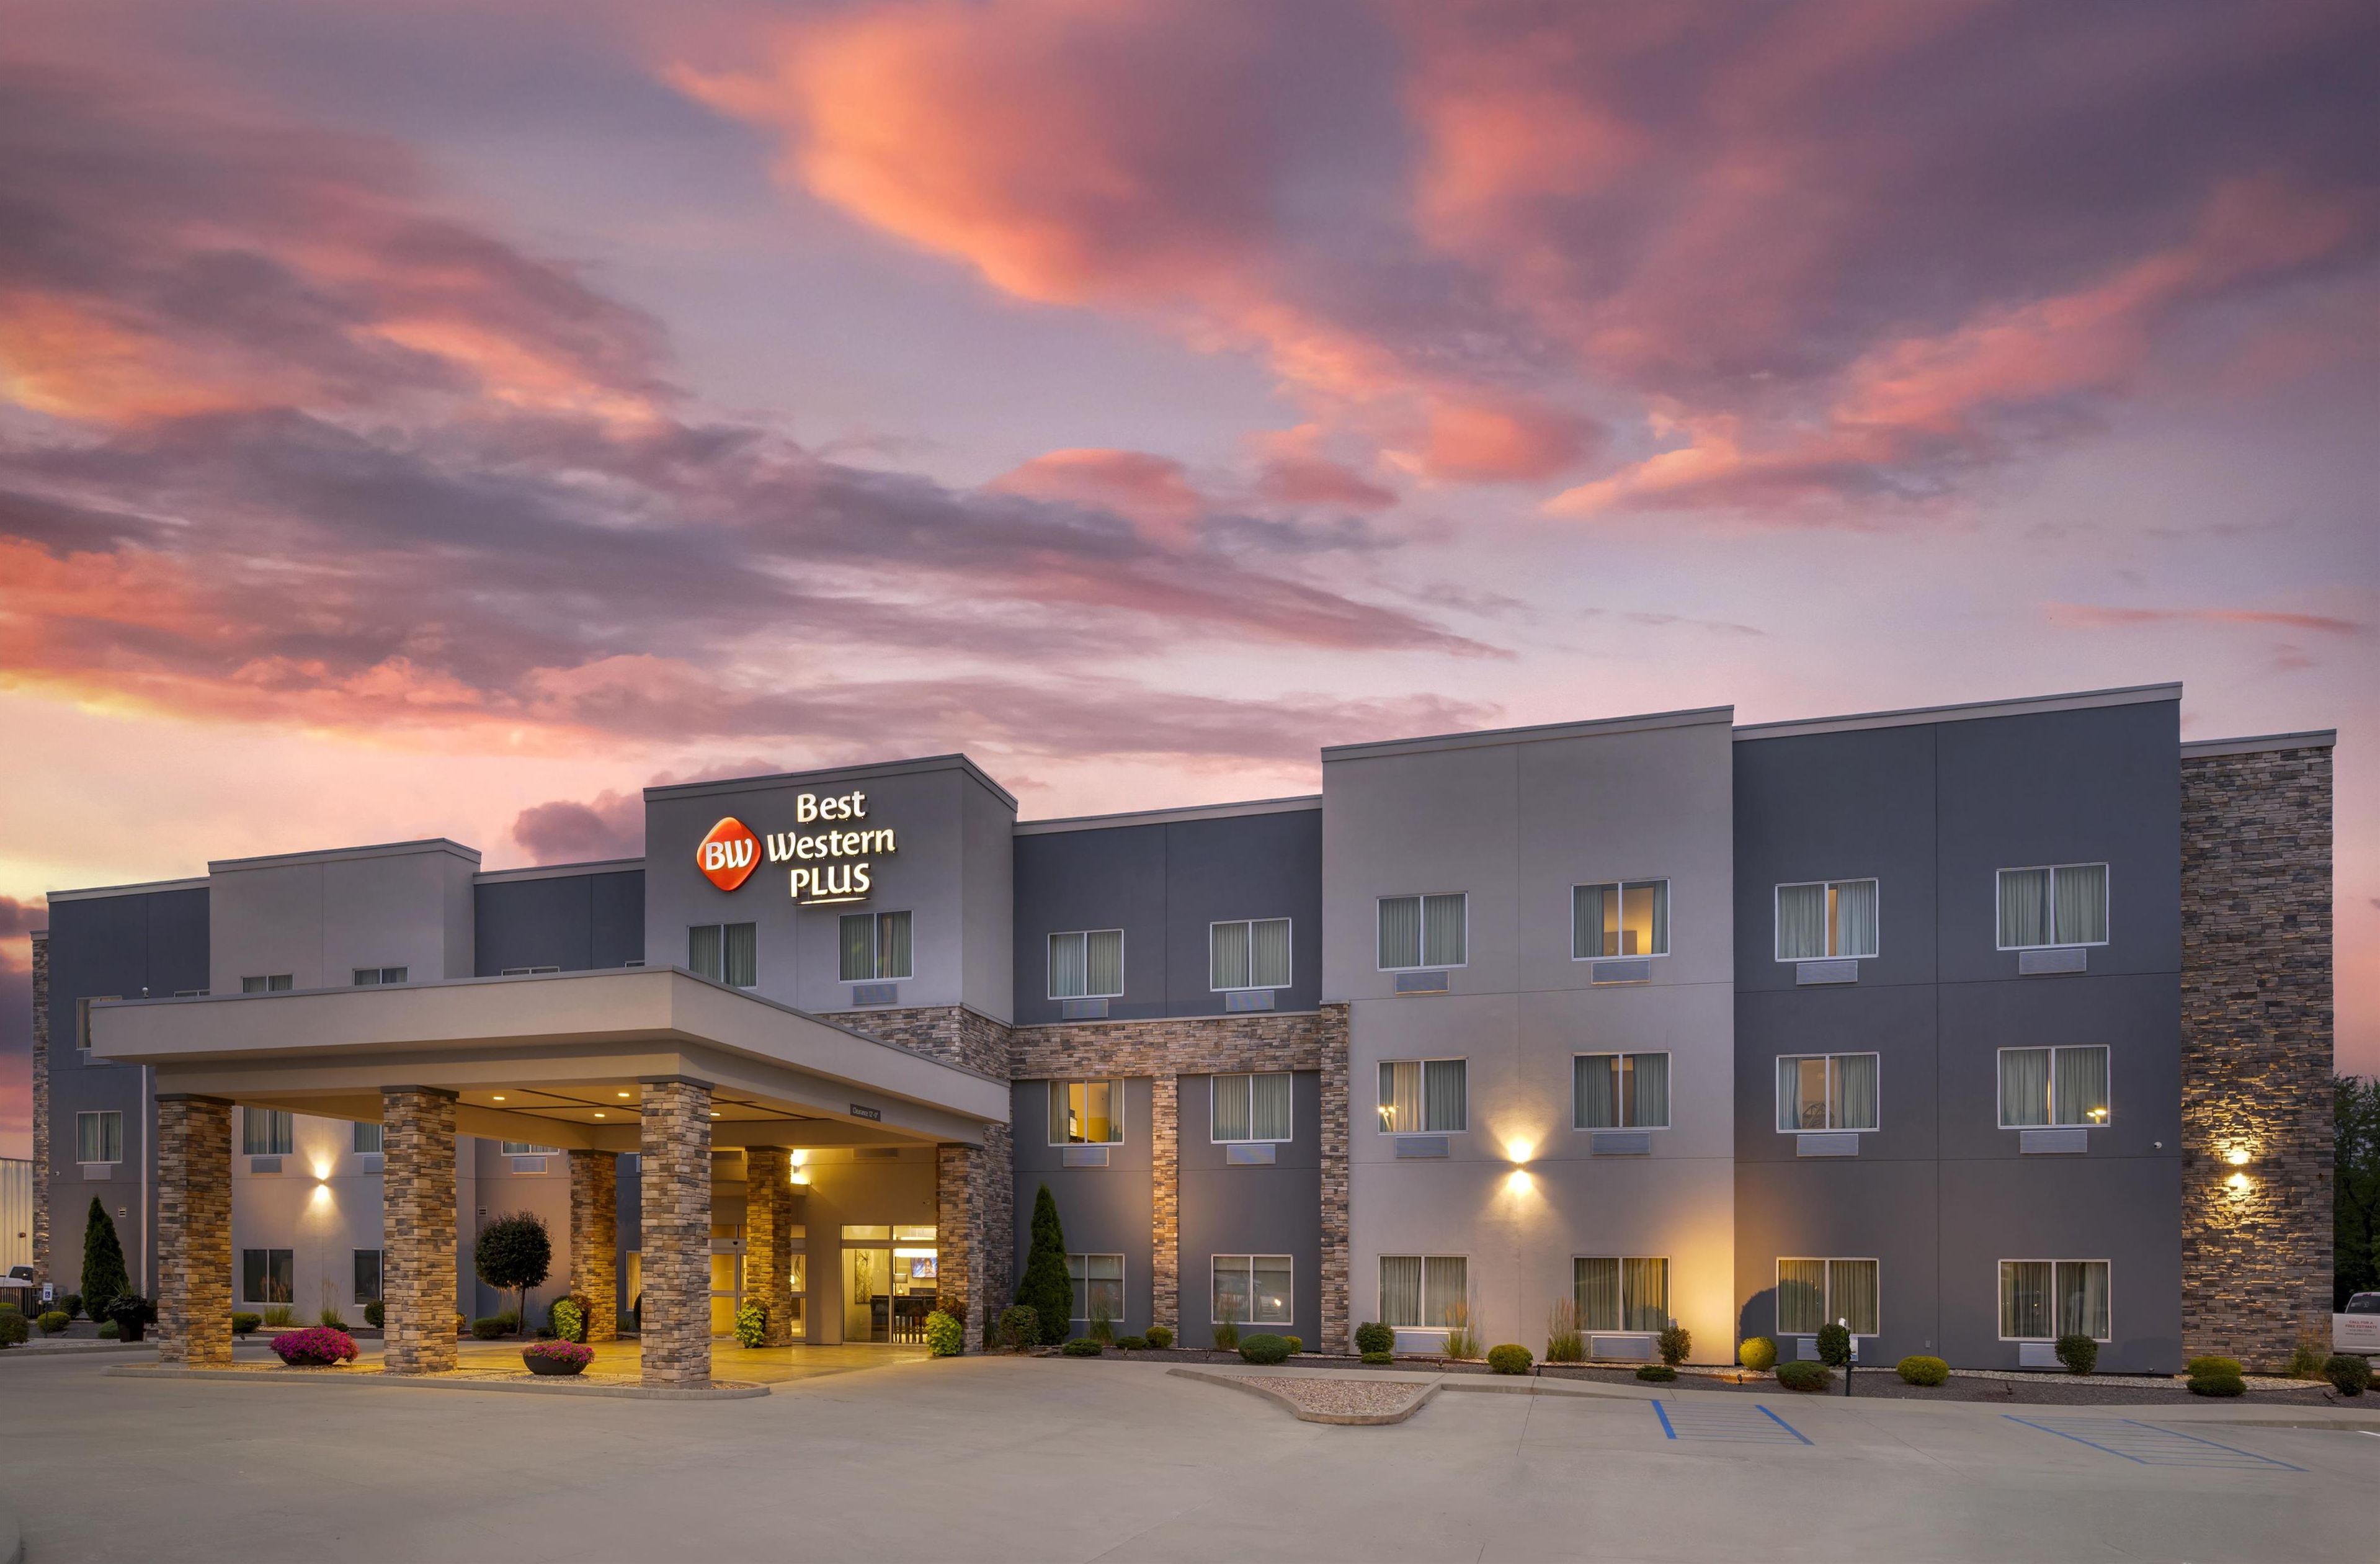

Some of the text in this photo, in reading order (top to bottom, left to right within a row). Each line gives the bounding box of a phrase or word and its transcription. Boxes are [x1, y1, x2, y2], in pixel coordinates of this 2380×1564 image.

[797, 791, 866, 823] Best
[706, 838, 753, 870] BW
[767, 828, 896, 862] Western
[790, 863, 871, 898] PLUS
